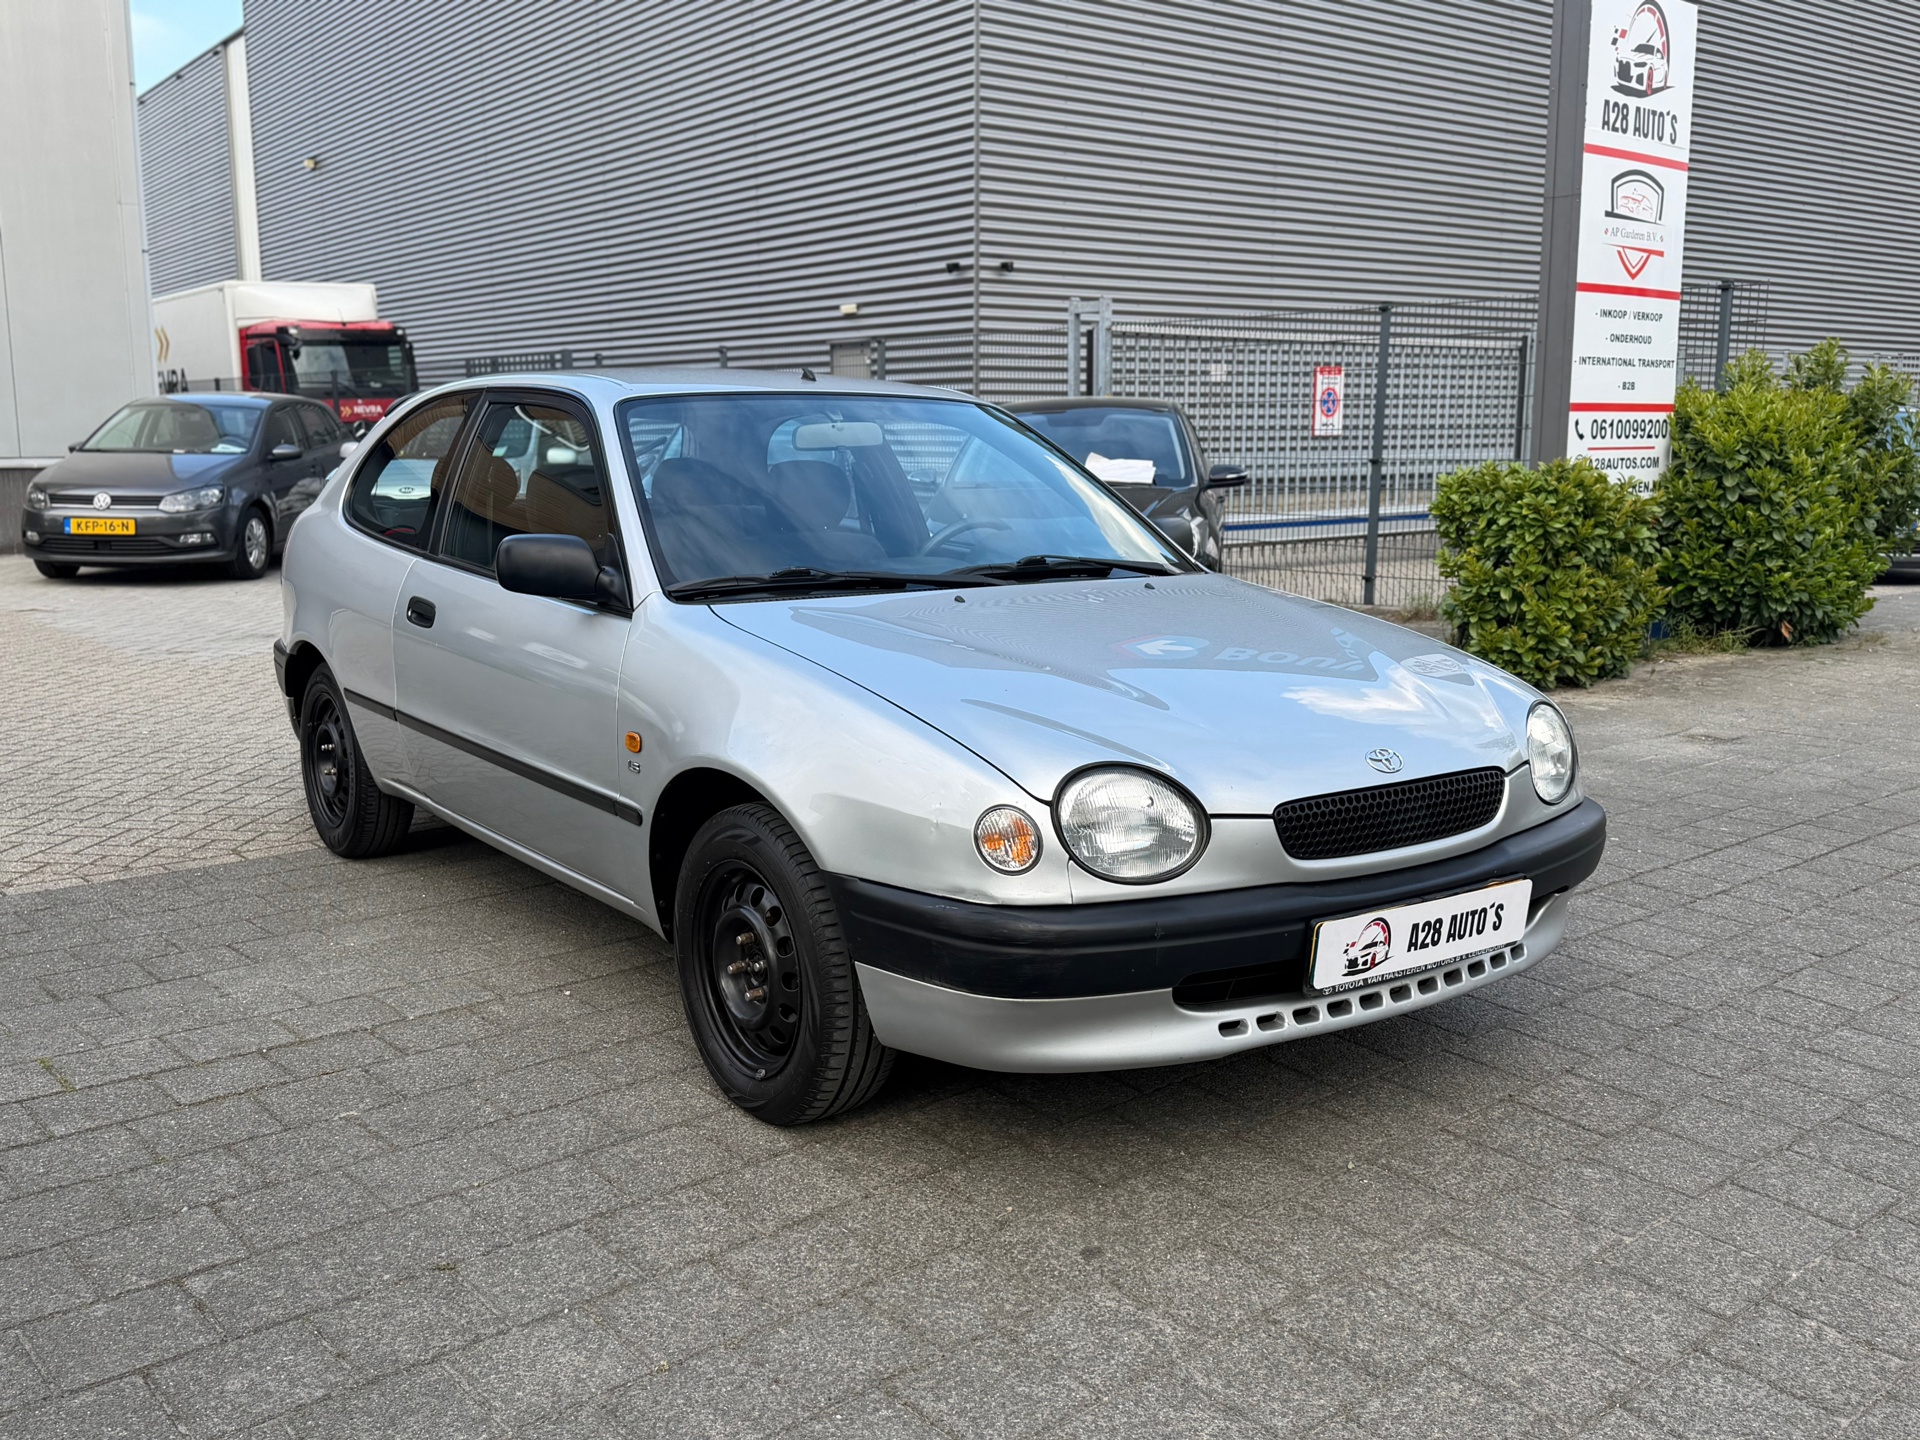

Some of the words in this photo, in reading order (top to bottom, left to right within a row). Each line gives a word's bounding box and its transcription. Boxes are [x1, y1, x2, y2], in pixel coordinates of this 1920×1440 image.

[1602, 99, 1629, 134] A28
[1610, 227, 1620, 237] AP
[1620, 227, 1645, 241] Garderen
[1600, 309, 1627, 319] INKOOP
[1633, 311, 1663, 322] VERKOOP
[1609, 333, 1652, 344] ONDERHOUD
[1579, 356, 1636, 367] INTERNATIONAL
[1638, 358, 1675, 368] TRANSPORT
[1622, 381, 1635, 390] B2B
[353, 404, 383, 414] NEVRA
[1590, 418, 1668, 440] 0610099200
[76, 520, 129, 532] KFP-16-N
[1407, 917, 1443, 953] A28
[1335, 981, 1364, 992] TOYOTA
[1367, 976, 1382, 984] VAN
